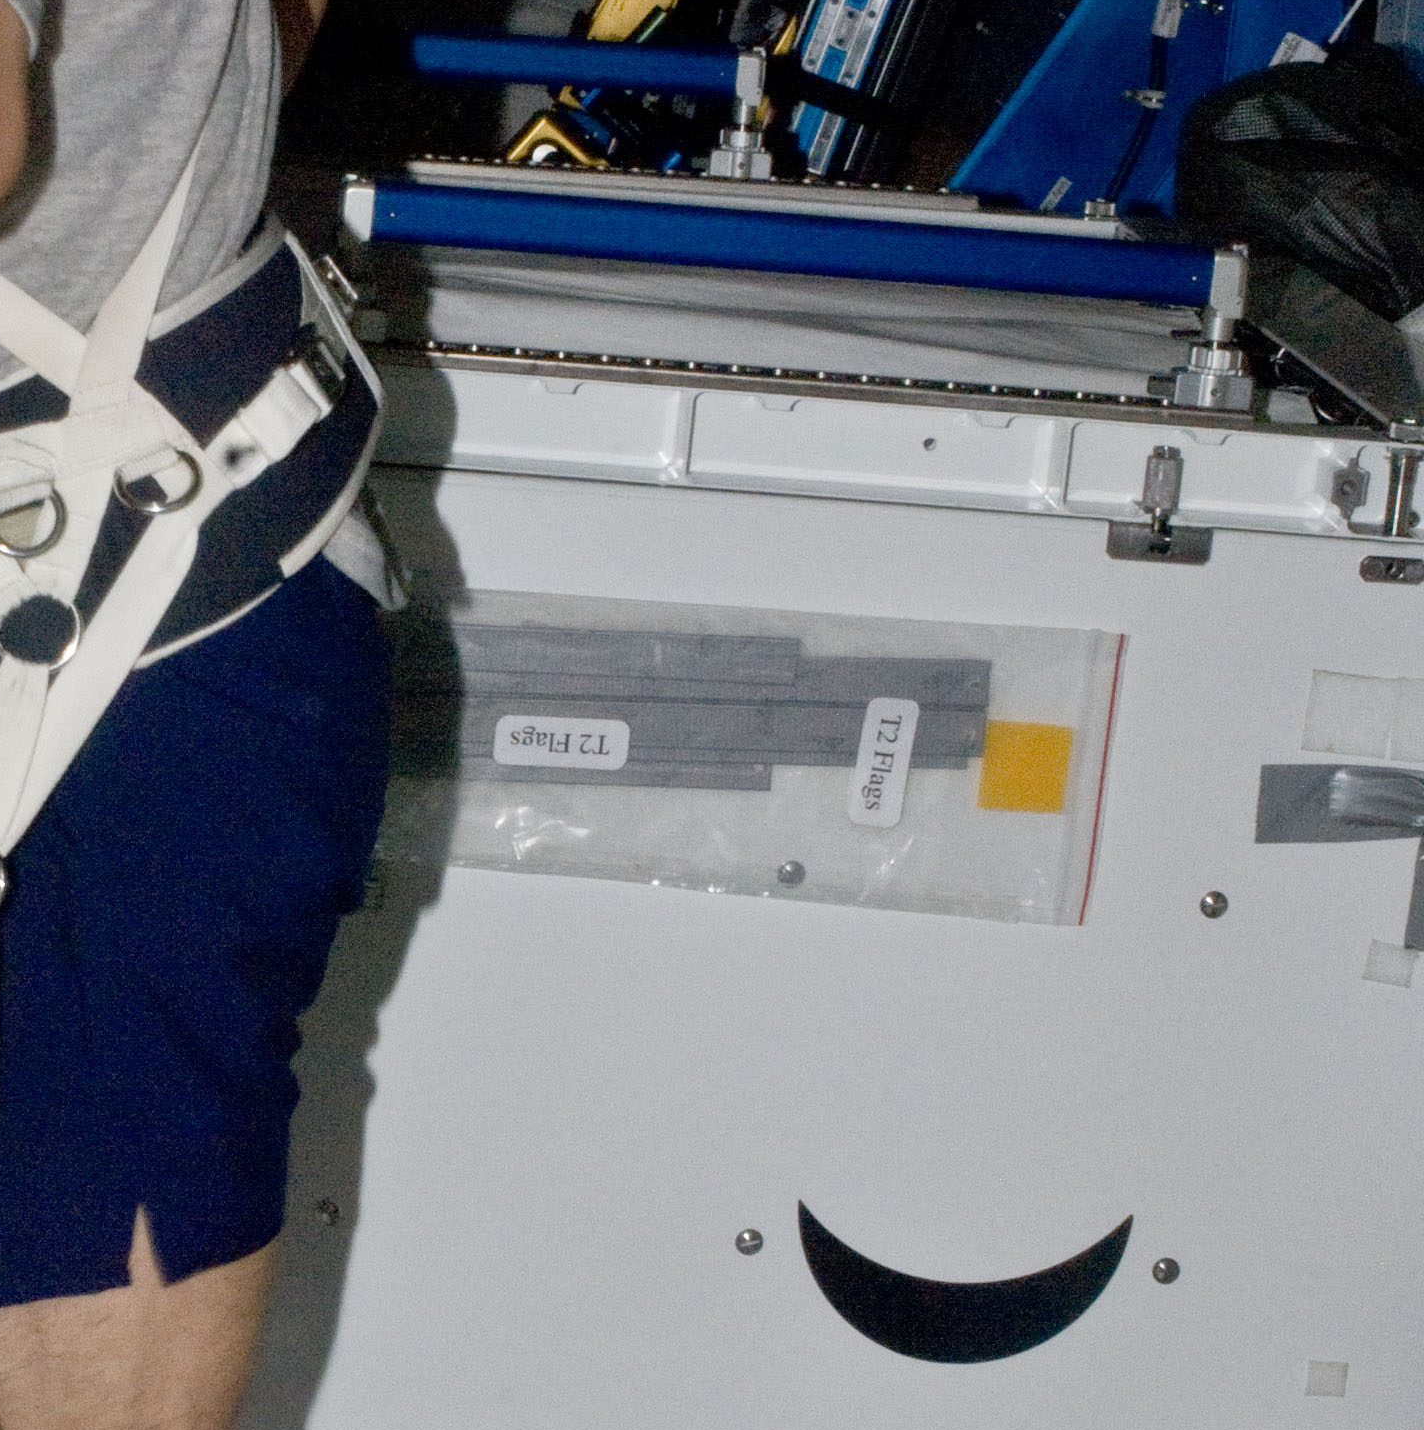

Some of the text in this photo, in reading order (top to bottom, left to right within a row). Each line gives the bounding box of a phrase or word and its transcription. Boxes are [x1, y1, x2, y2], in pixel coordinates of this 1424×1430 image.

[510, 726, 610, 755] T2 Flags
[861, 715, 902, 810] T2 Flags
